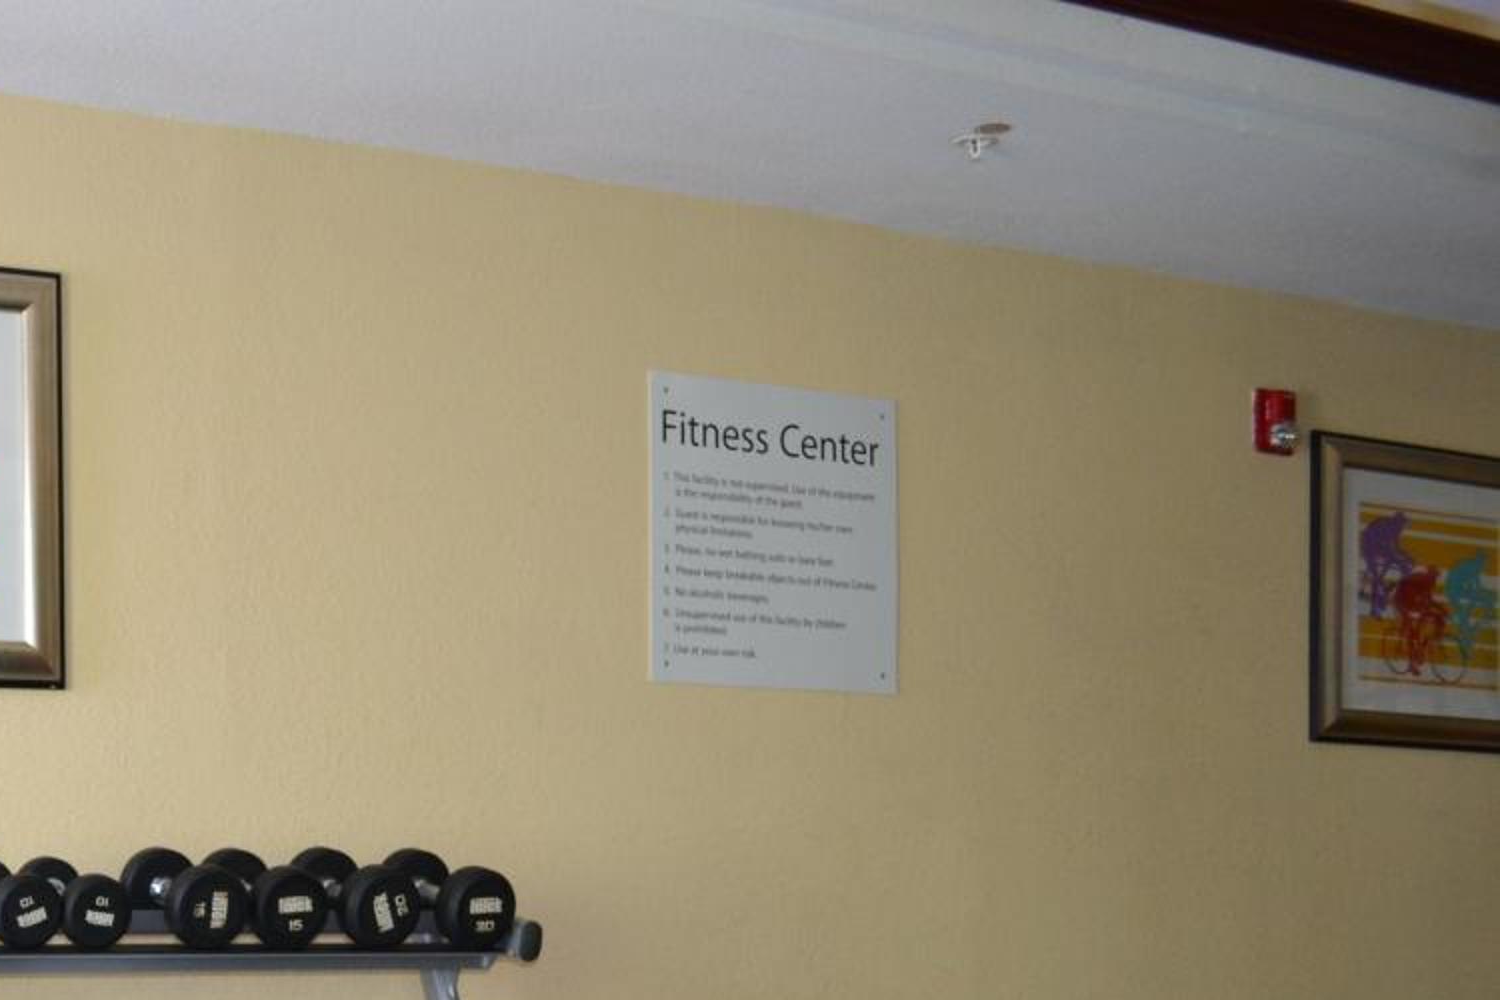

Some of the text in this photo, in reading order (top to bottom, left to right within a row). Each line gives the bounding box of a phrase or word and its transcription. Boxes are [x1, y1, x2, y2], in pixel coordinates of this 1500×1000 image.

[661, 409, 879, 467] Fitness Center
[94, 896, 109, 906] 10
[288, 919, 304, 931] 15
